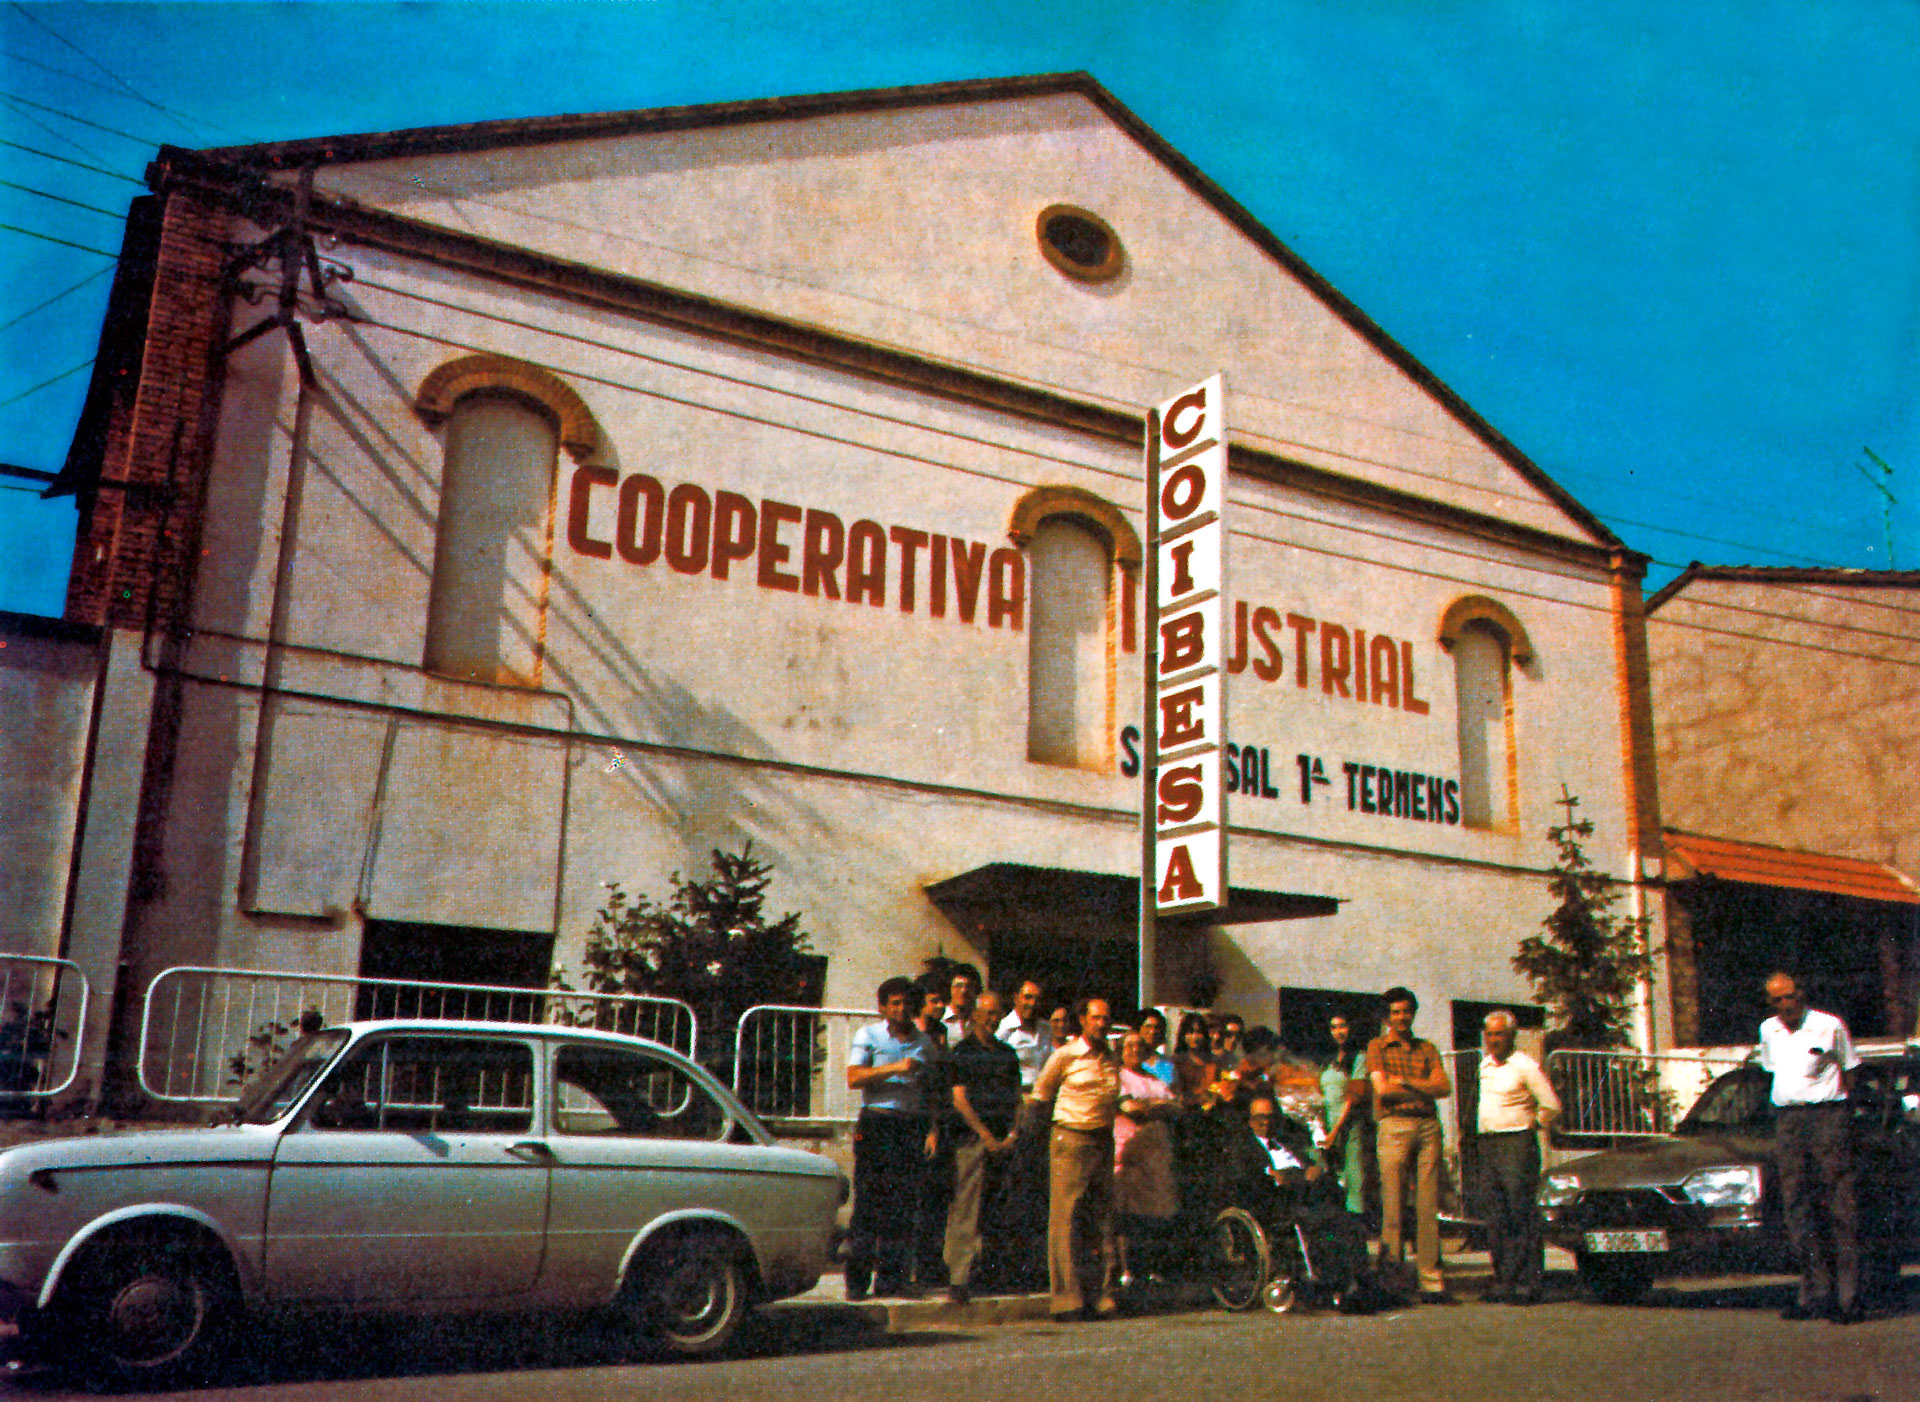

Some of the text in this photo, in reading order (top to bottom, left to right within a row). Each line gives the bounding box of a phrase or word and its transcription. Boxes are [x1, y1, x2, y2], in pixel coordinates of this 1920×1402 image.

[568, 464, 1430, 716] COOPERATIVA IUSTRIAL
[1158, 386, 1207, 903] COIBESA
[1120, 725, 1279, 799] SSAL
[1342, 761, 1460, 826] TERMENS
